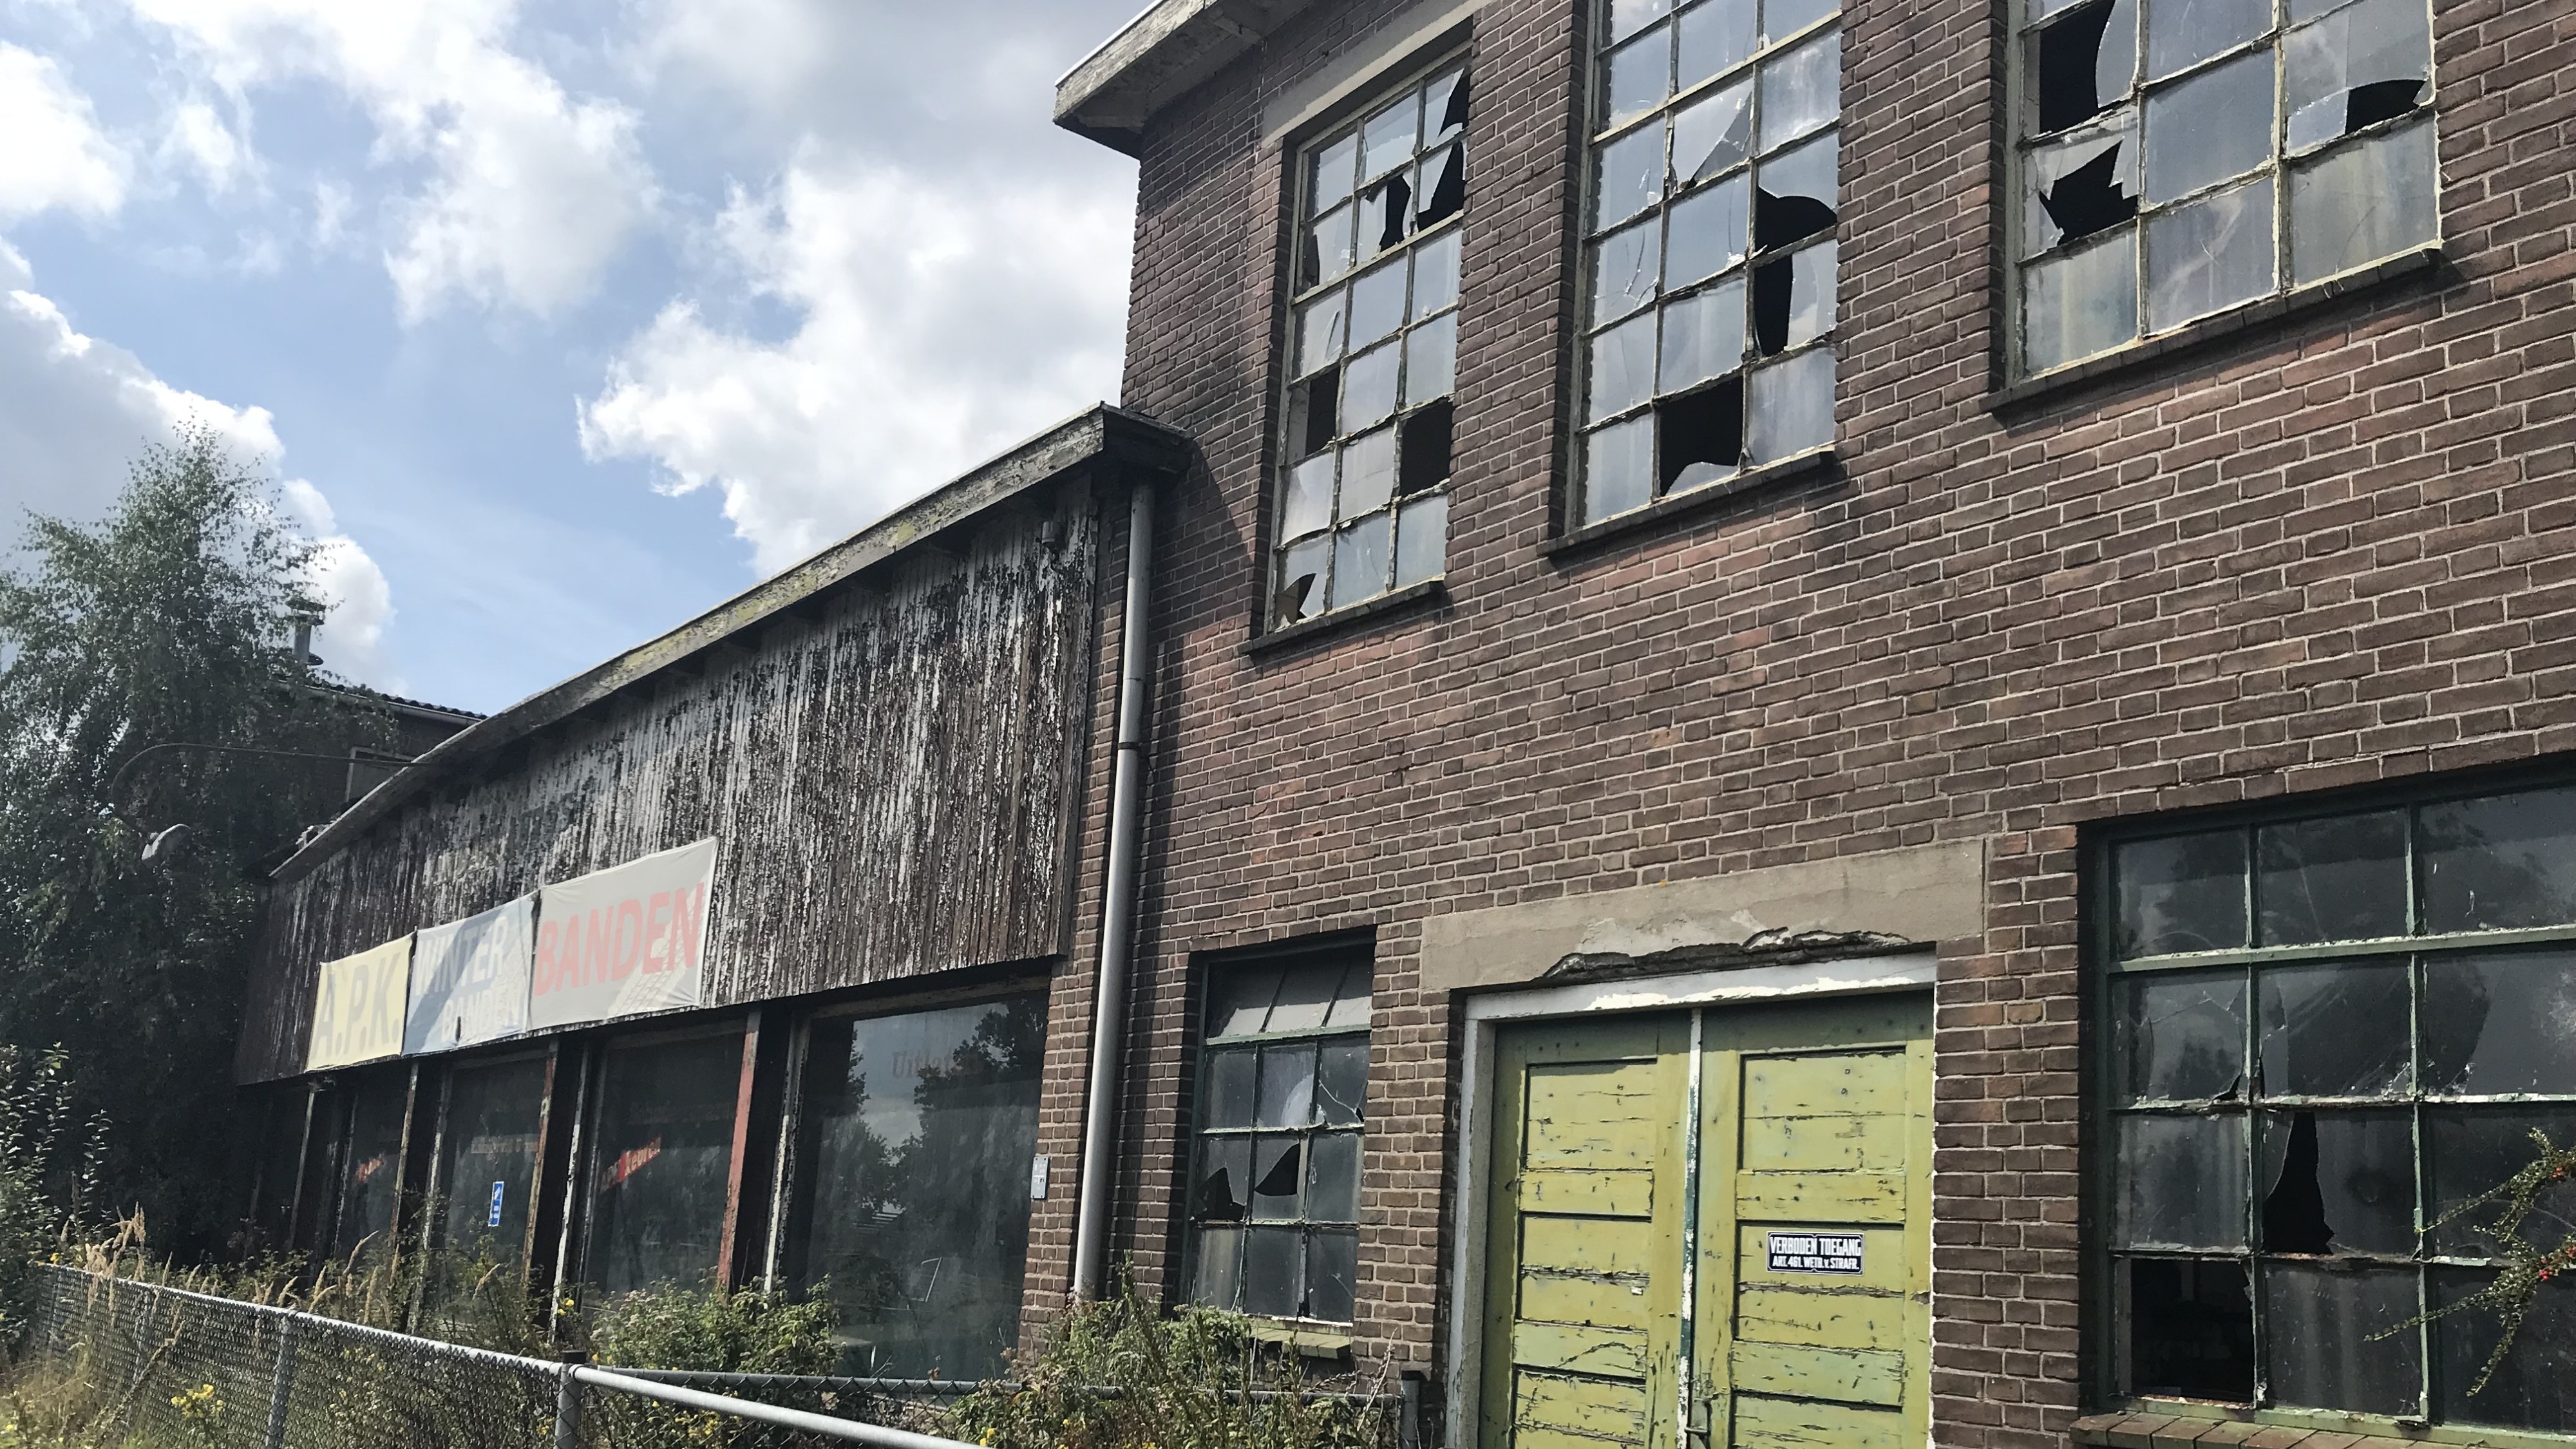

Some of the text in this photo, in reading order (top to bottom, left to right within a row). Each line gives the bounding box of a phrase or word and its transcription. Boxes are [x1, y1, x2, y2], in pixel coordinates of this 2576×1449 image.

[414, 915, 509, 996] WINTER
[533, 882, 705, 996] BANDEN
[1770, 1236, 1862, 1256] VERBODEN TOEGANG
